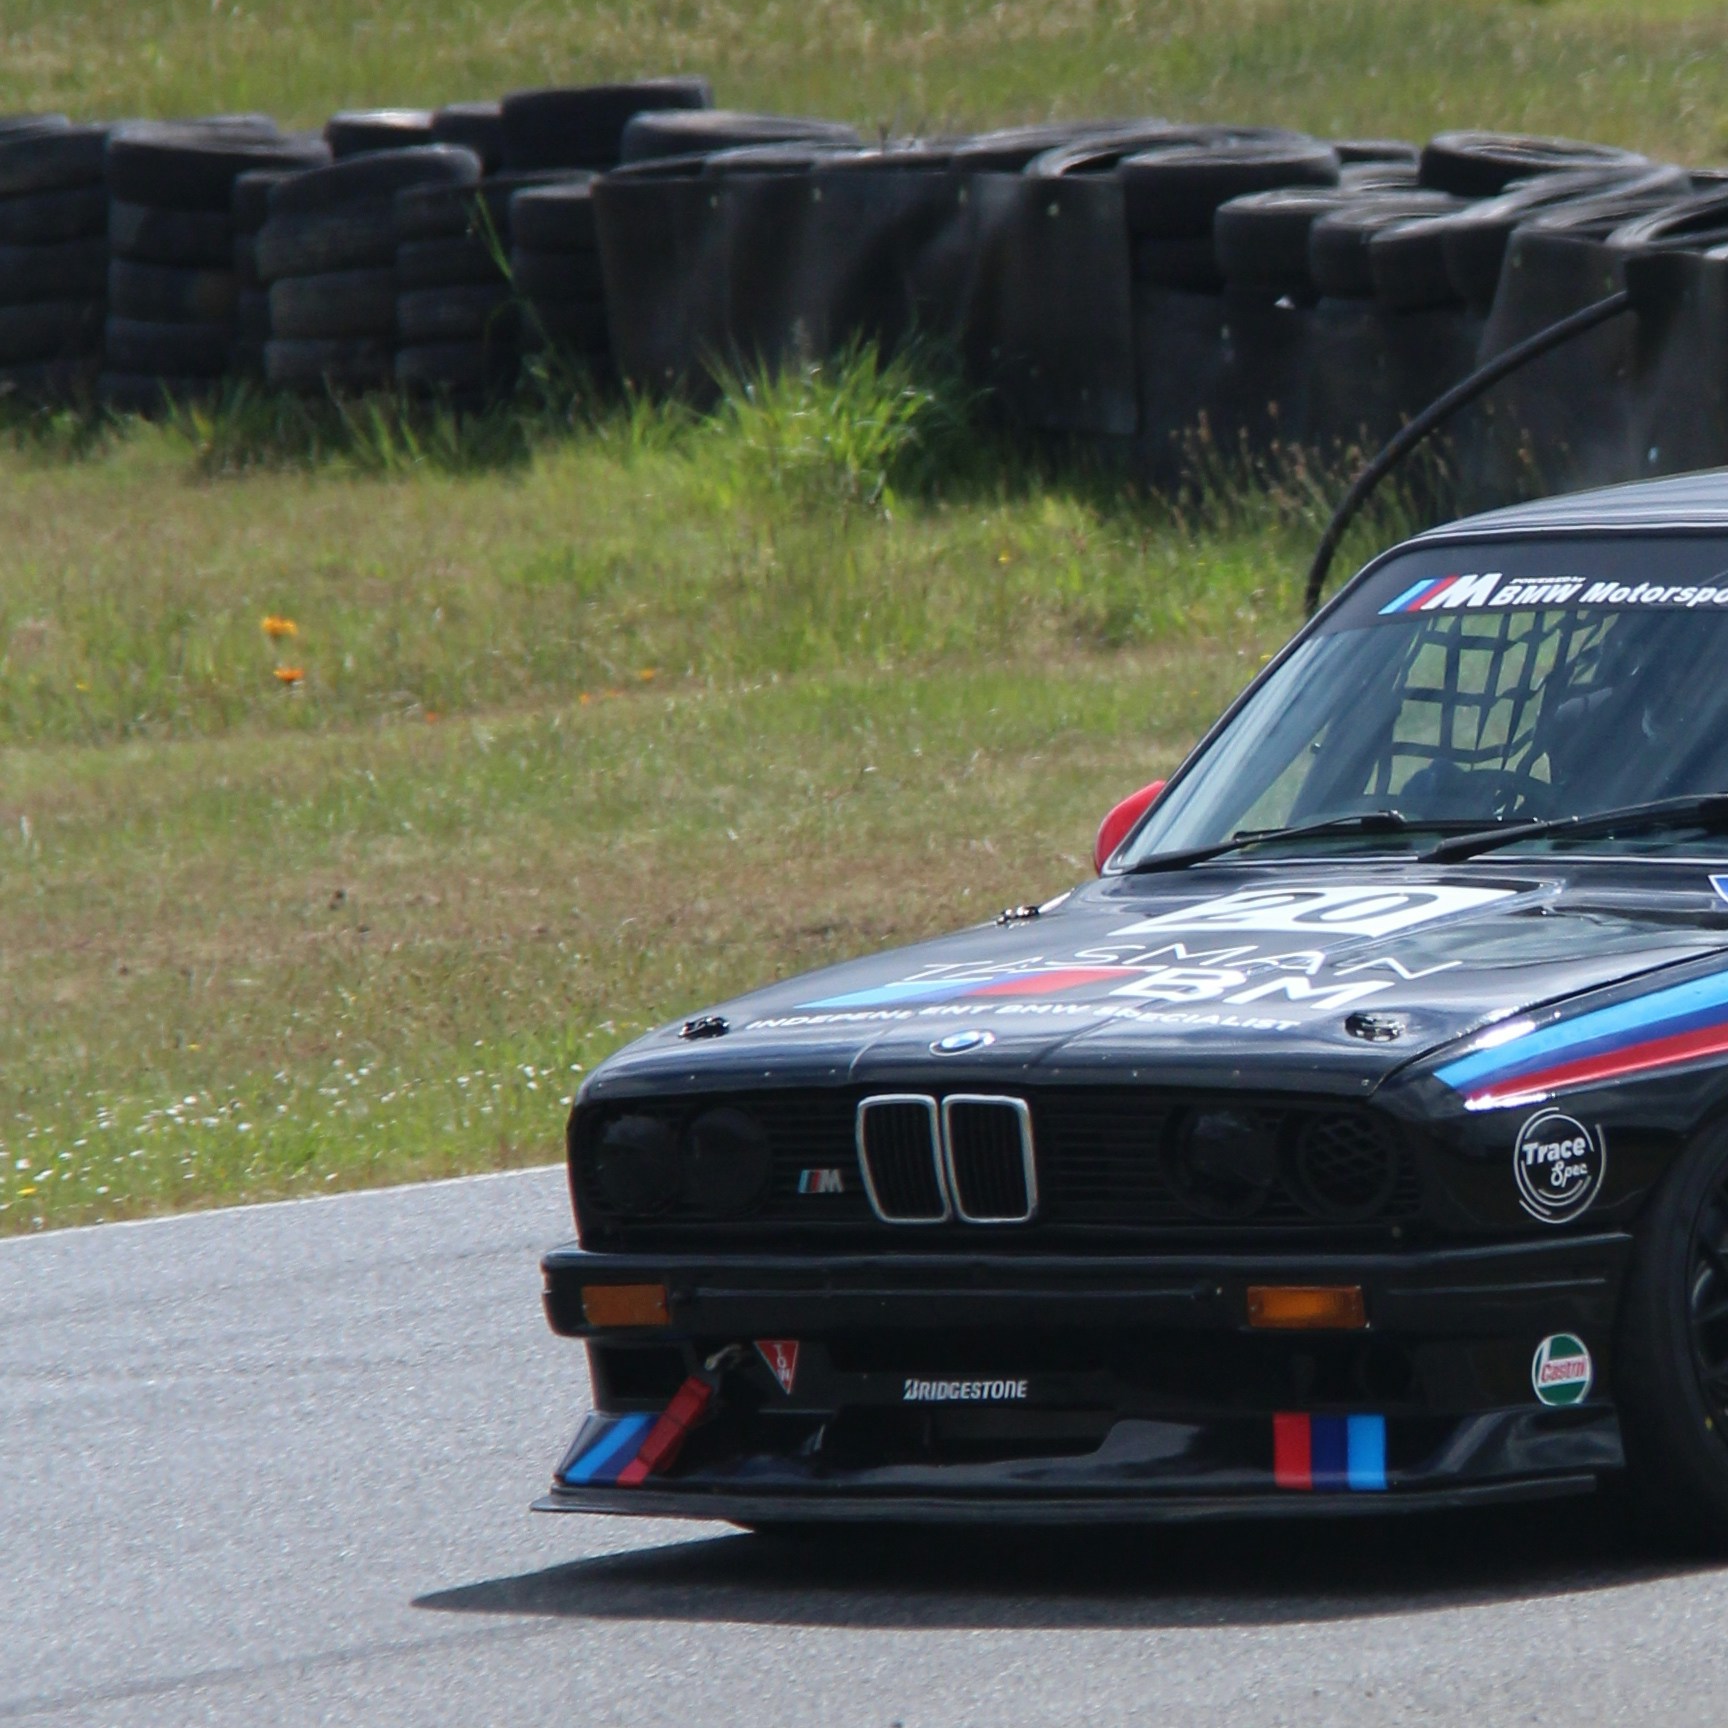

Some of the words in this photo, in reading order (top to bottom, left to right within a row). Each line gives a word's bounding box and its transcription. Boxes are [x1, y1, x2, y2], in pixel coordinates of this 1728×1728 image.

[1488, 584, 1584, 607] BMW
[1138, 891, 1439, 927] 20
[904, 942, 1463, 981] TASMAN
[744, 1003, 995, 1030] INDEPENDENT
[993, 1003, 1092, 1018] BMW
[1092, 1005, 1302, 1032] SPECIALIST
[1522, 1136, 1587, 1166] Trace
[1549, 1159, 1589, 1188] Spec
[772, 1343, 792, 1381] TOW
[903, 1378, 1029, 1401] BRIDGESTONE
